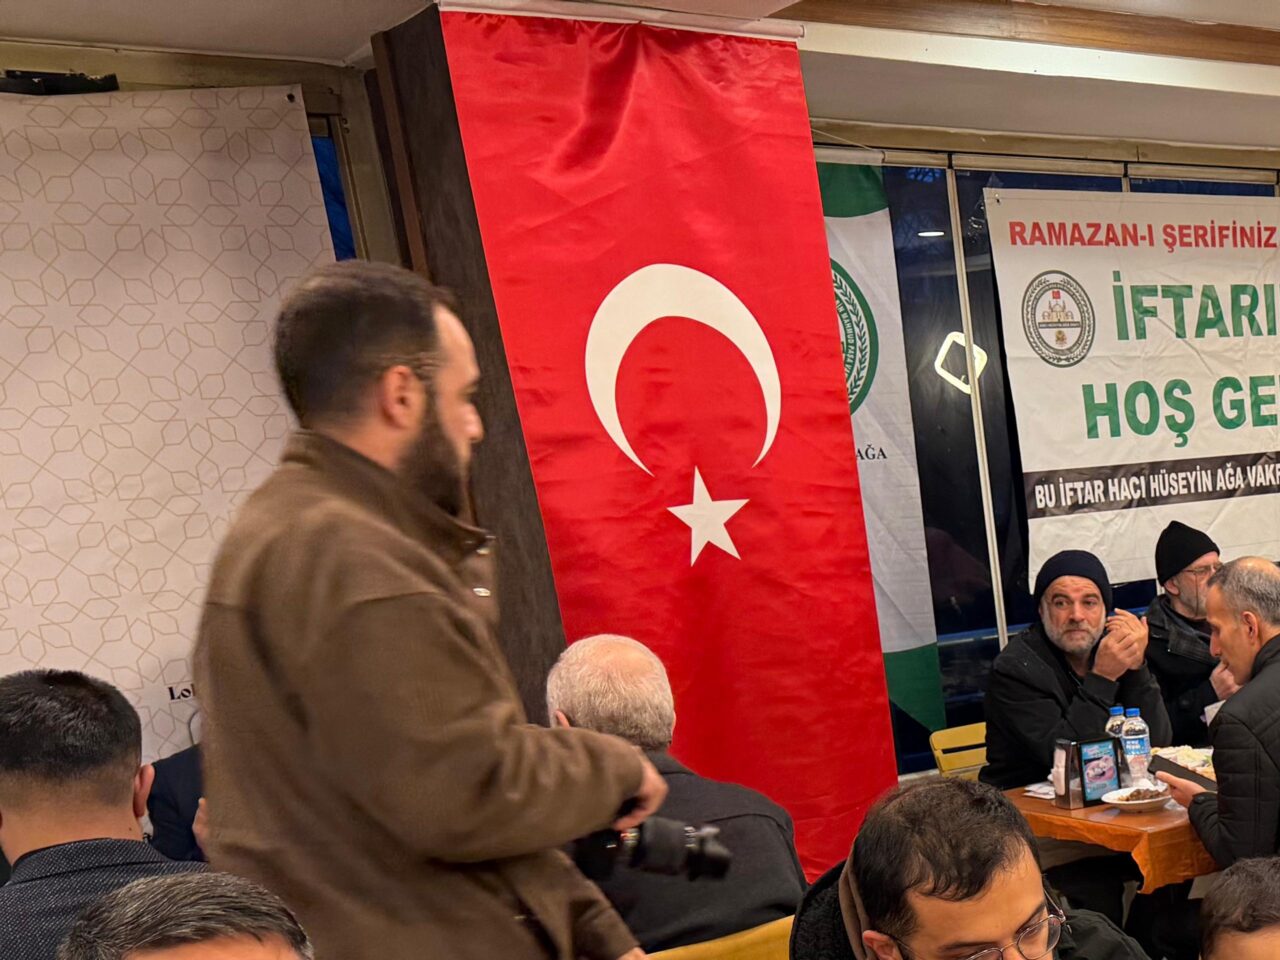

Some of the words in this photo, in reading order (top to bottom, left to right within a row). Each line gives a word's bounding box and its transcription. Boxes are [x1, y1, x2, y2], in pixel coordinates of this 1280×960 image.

[1009, 220, 1155, 247] RAMAZAN-I
[1162, 220, 1278, 253] ŞERİFİNİZ
[1081, 378, 1195, 448] HOŞ
[855, 444, 888, 461] AĞA
[1034, 483, 1057, 509] BU
[1059, 477, 1105, 507] İFTAR
[1107, 475, 1147, 501] HACI
[1149, 465, 1214, 498] HÜSEYİN
[1215, 462, 1246, 490] AĞA
